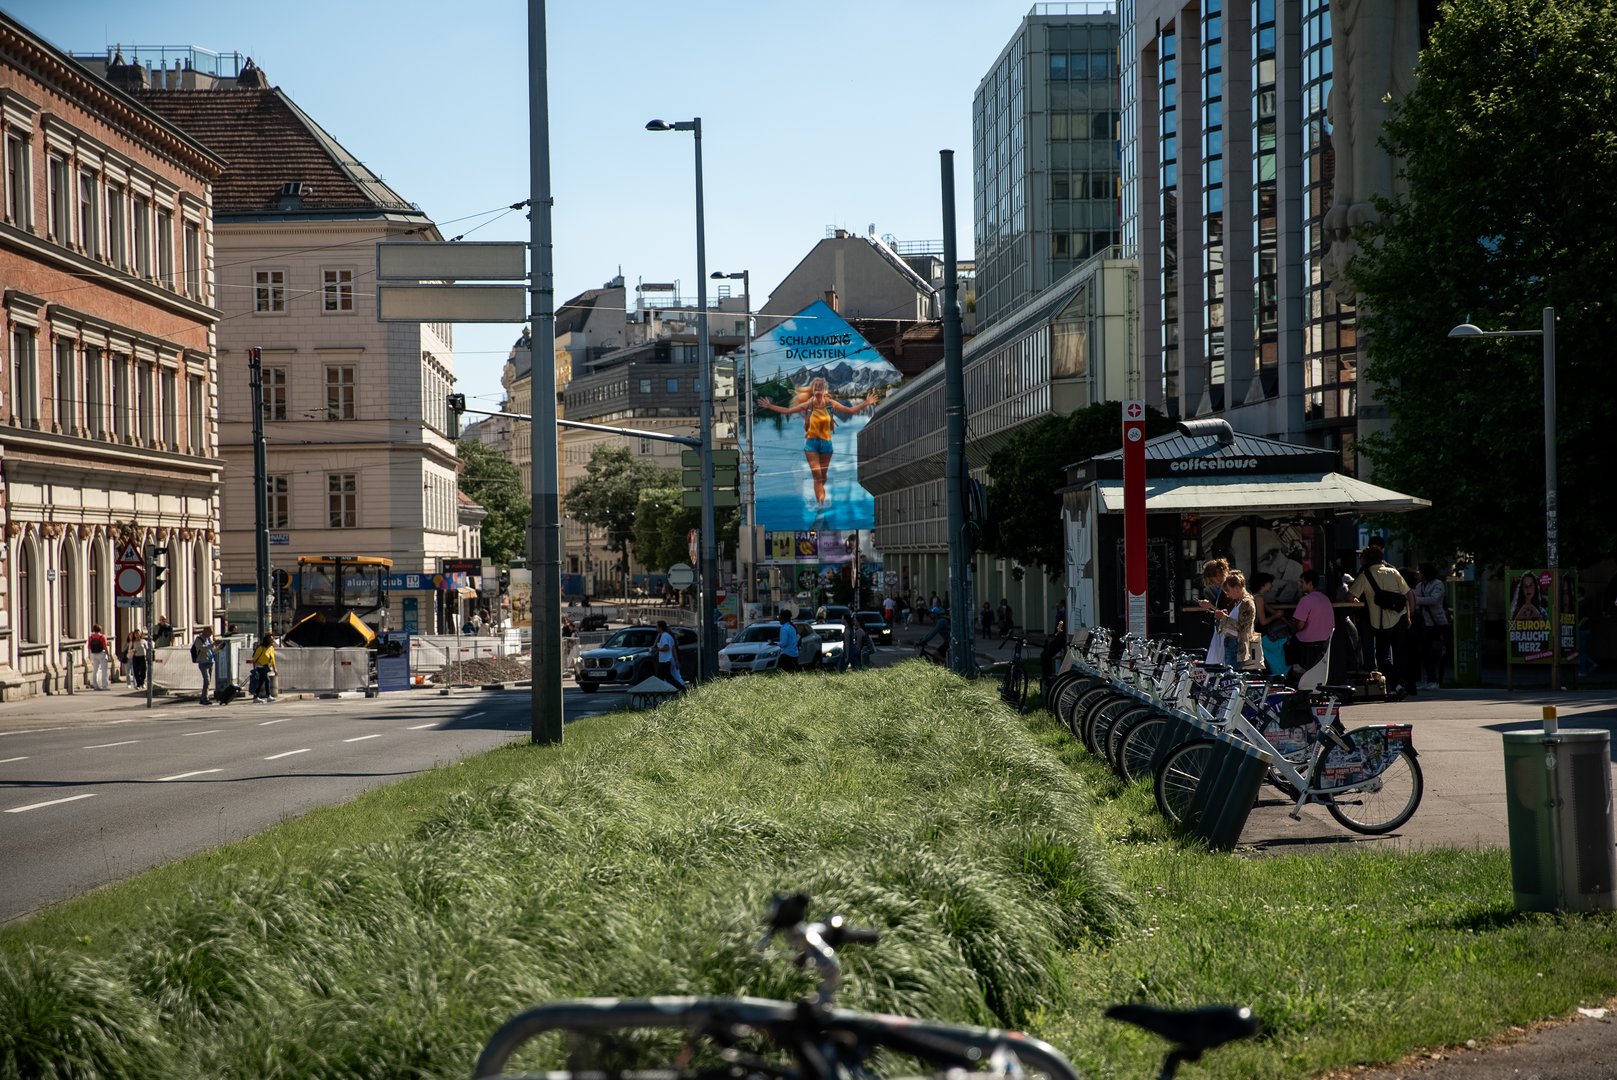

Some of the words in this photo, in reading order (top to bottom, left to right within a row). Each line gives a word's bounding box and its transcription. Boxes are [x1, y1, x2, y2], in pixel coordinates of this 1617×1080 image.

[780, 334, 851, 346] SCHLADMING
[786, 349, 846, 361] DACHSTEIN
[1170, 458, 1258, 470] coffeehouse
[382, 578, 402, 586] club
[1517, 620, 1551, 631] EUROPA
[1510, 631, 1550, 641] BRAUCHT
[1518, 642, 1541, 652] HERZ
